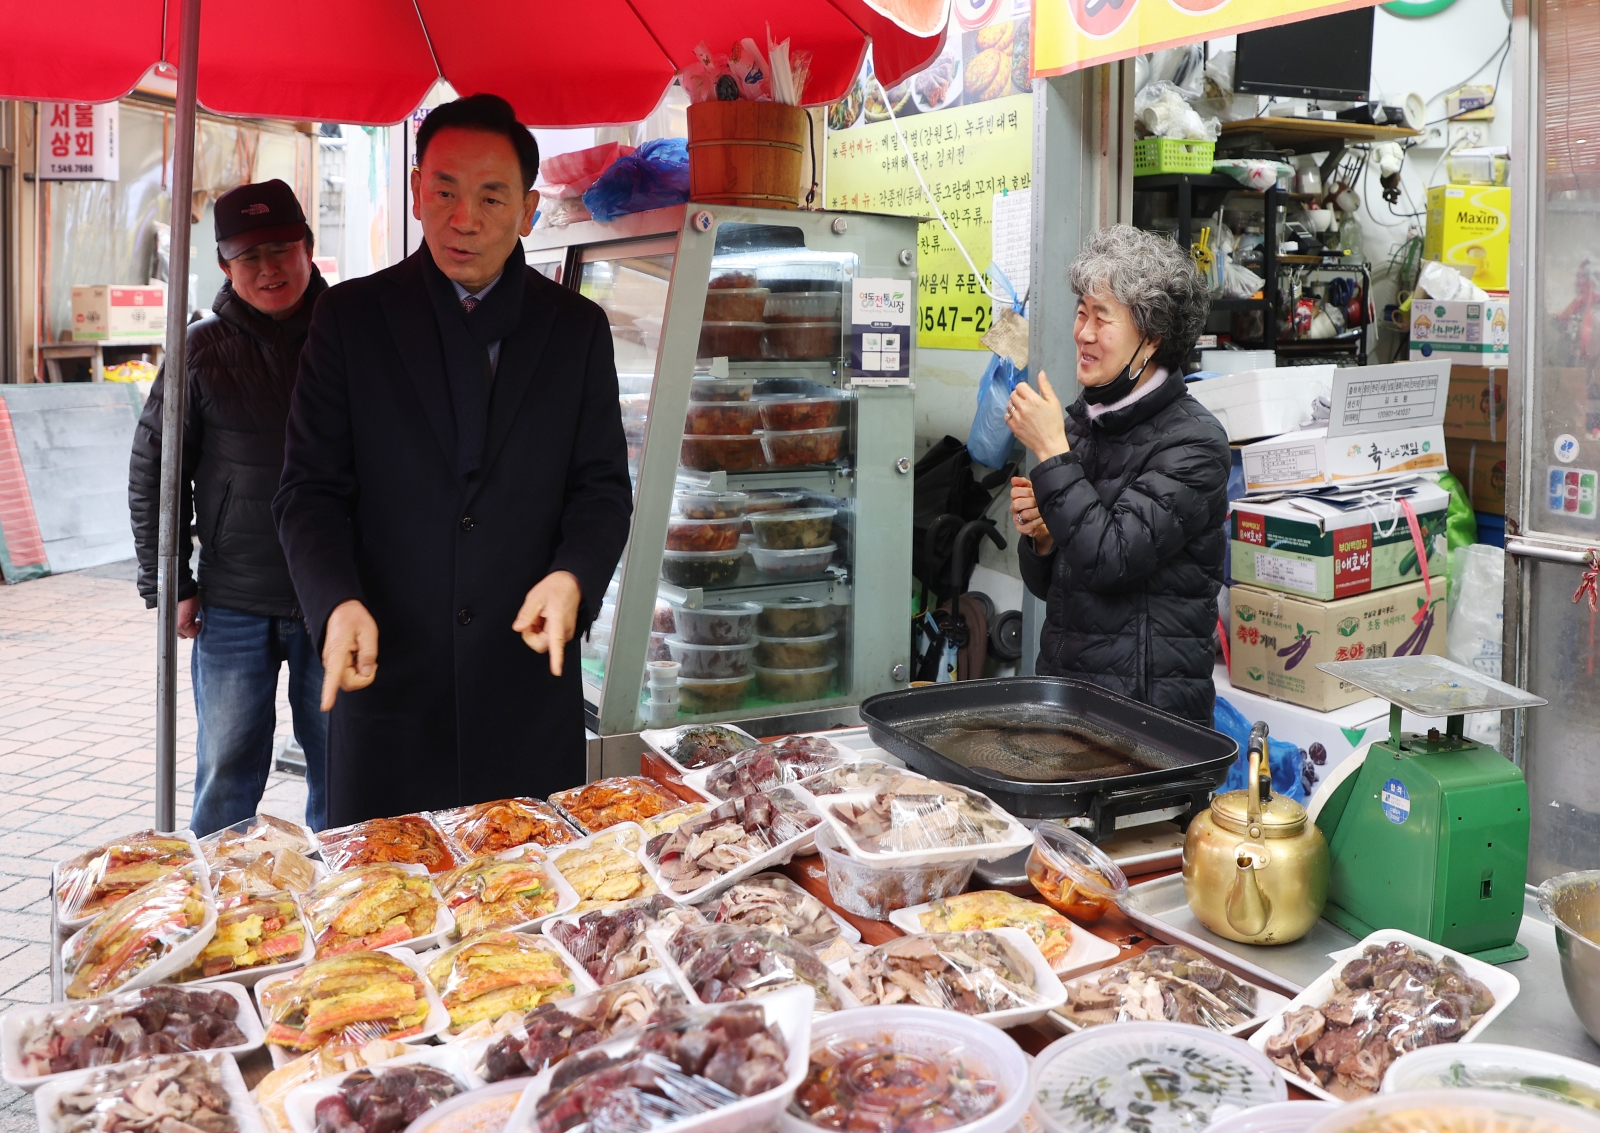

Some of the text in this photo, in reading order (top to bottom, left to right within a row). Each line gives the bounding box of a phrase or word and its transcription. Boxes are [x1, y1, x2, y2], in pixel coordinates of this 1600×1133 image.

[50, 103, 93, 128] 서울
[965, 110, 1018, 138] 녹두빈대떡
[50, 131, 93, 157] 상회
[936, 144, 965, 169] 김치전
[1456, 210, 1499, 225] Maxim
[1400, 441, 1419, 457] 깻잎
[1549, 483, 1593, 502] JCB
[1244, 529, 1262, 543] 애호박
[1338, 538, 1368, 553] 부여백마강
[1341, 550, 1371, 572] 애호박
[1367, 613, 1406, 631] 초동 아리아리
[1259, 634, 1277, 651] 가지
[1366, 641, 1387, 660] 가지
